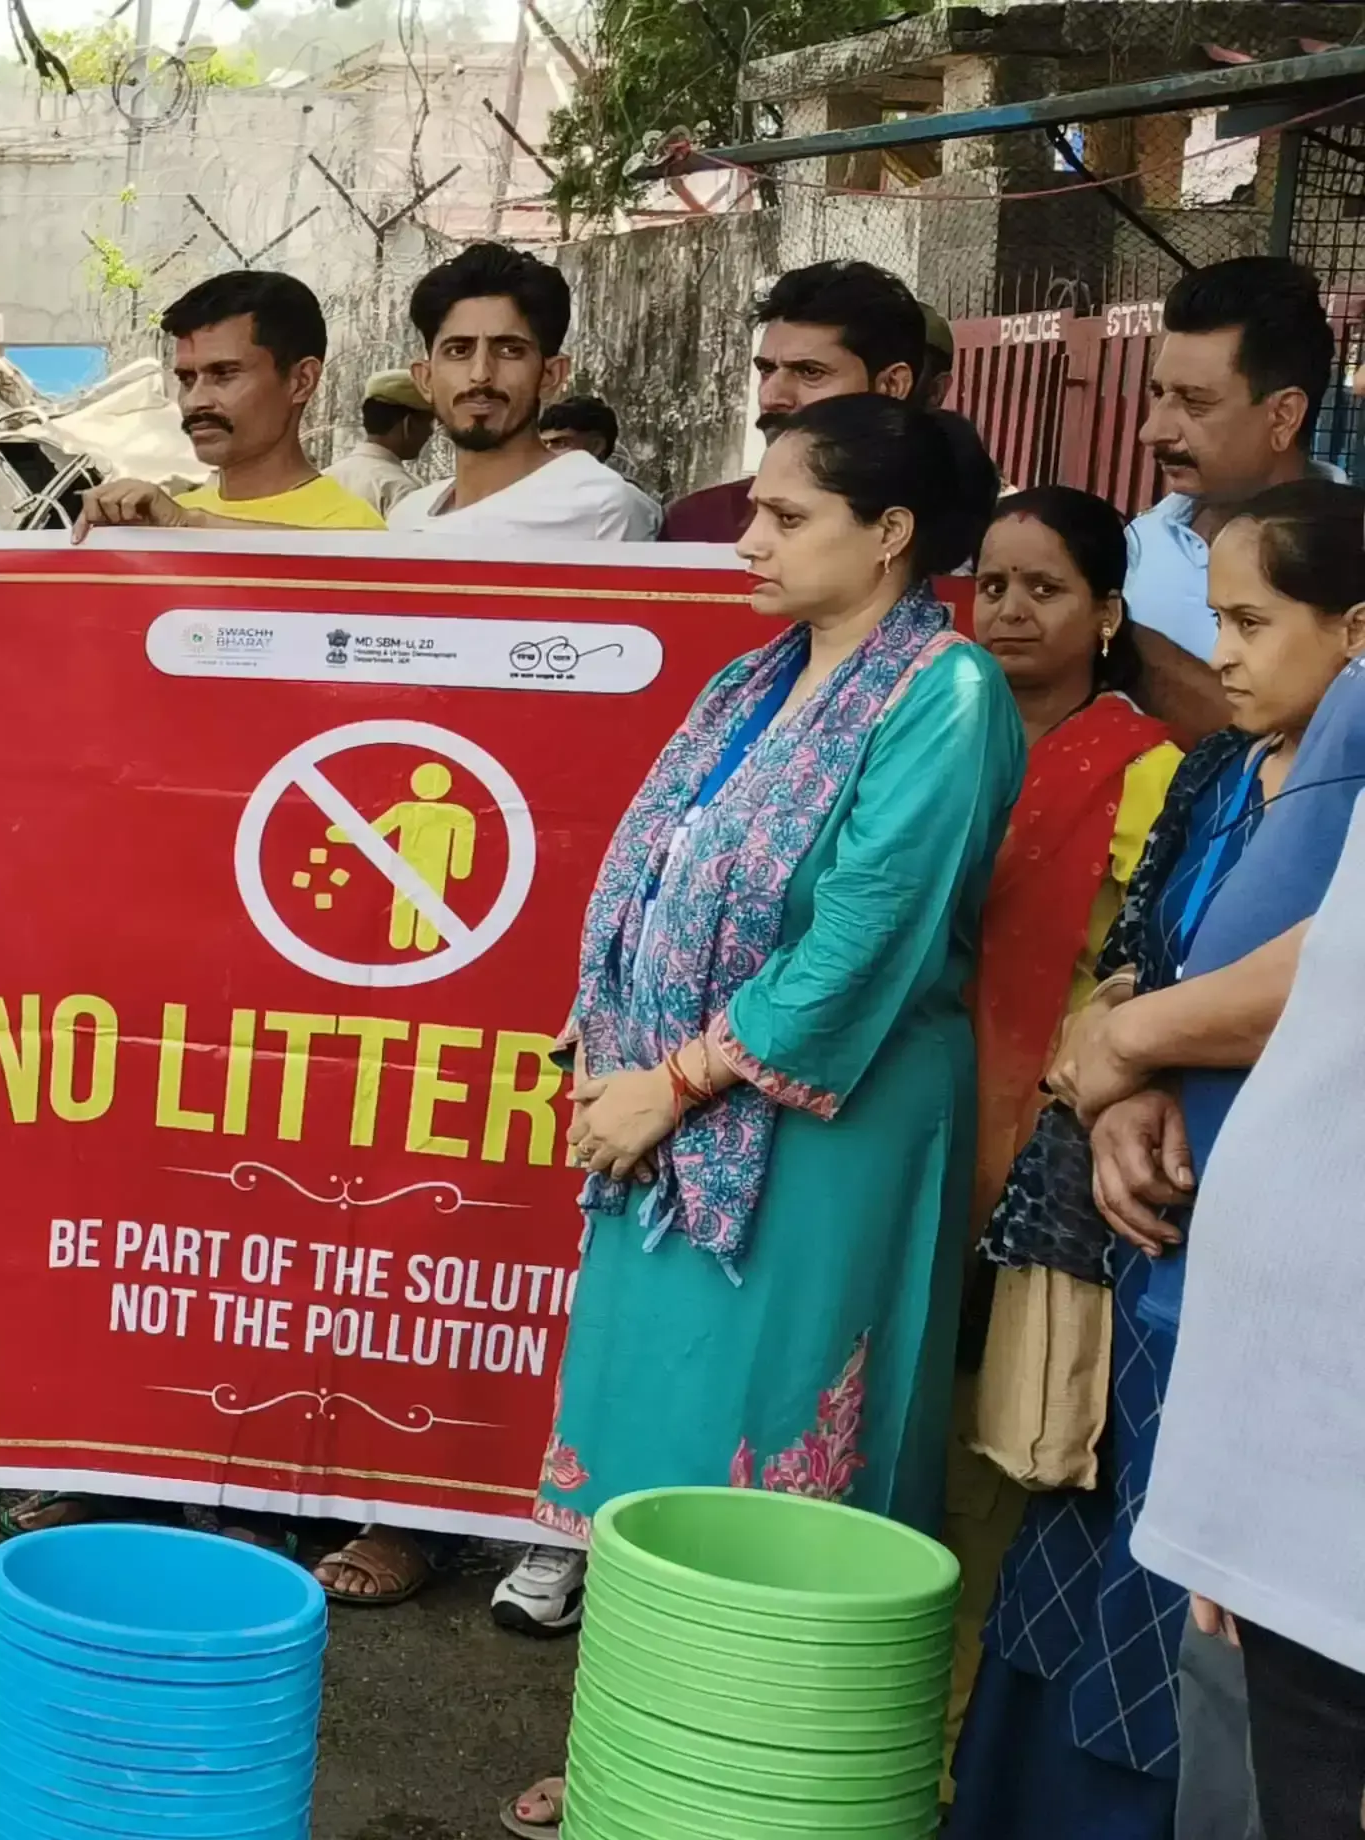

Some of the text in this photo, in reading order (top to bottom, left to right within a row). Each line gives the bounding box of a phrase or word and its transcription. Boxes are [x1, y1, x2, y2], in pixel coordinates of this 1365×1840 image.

[1000, 302, 1166, 344] POLICE STAT
[216, 637, 273, 649] BHARAT
[217, 627, 274, 638] SWACHH
[355, 636, 373, 647] MD
[154, 1002, 583, 1169] LITTER
[49, 1219, 103, 1269] BE
[115, 1220, 230, 1275] PART
[241, 1234, 297, 1287] OF
[309, 1243, 393, 1300] THE
[109, 1282, 548, 1377] NOT THE POLLUTION
